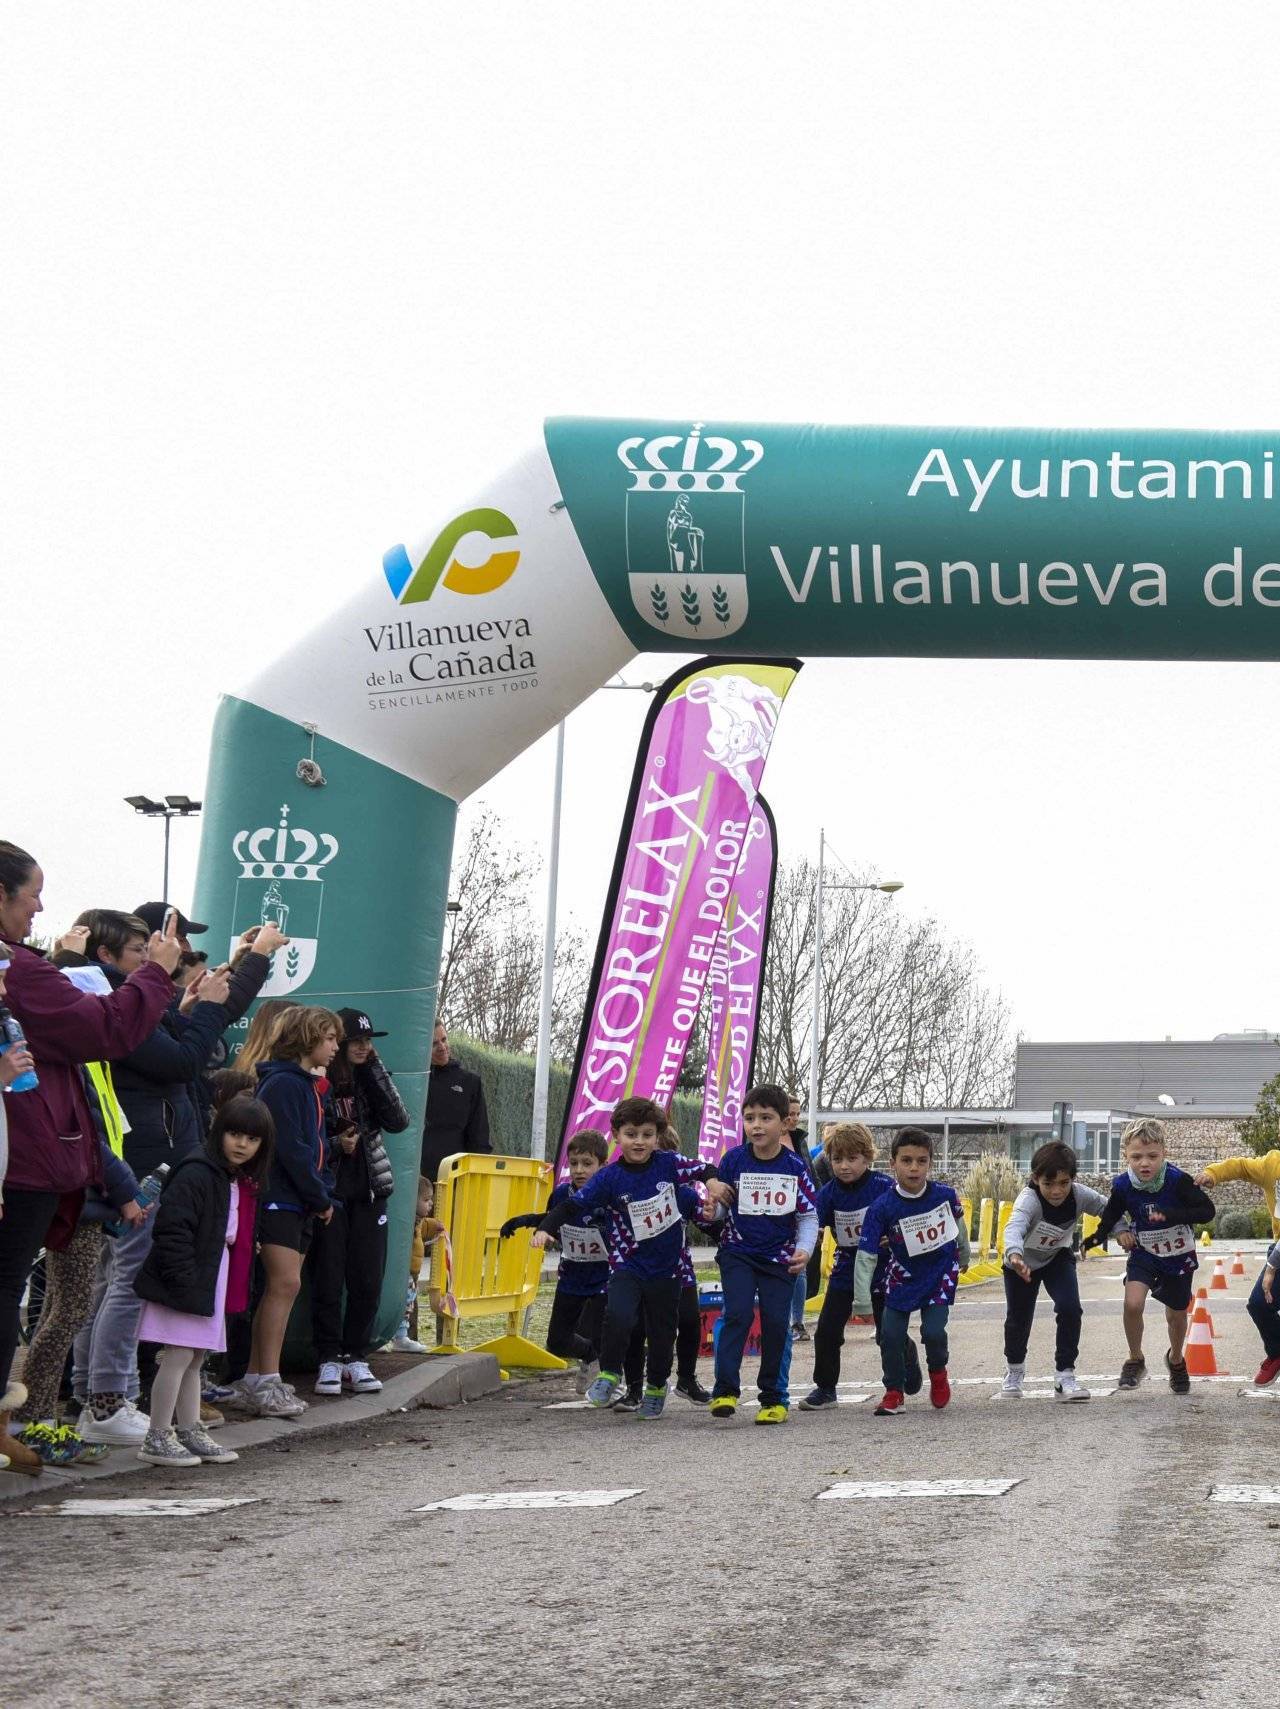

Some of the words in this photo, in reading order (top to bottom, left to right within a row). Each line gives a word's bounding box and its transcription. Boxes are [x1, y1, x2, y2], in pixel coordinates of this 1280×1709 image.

[770, 545, 1168, 607] Villanueva
[363, 617, 532, 652] Villanueva
[366, 672, 386, 687] de
[390, 671, 403, 685] la
[409, 643, 536, 682] Cañada
[368, 687, 496, 711] SENCILLAMENTE
[502, 678, 539, 693] TODO
[698, 818, 747, 925] DOLOR
[689, 930, 719, 962] EL
[673, 965, 707, 1033] QUE
[751, 1191, 786, 1205] 110
[643, 1203, 672, 1228] 114
[844, 1225, 863, 1238] 10
[569, 1240, 601, 1254] 112
[915, 1220, 946, 1244] 107
[1152, 1238, 1185, 1254] 113
